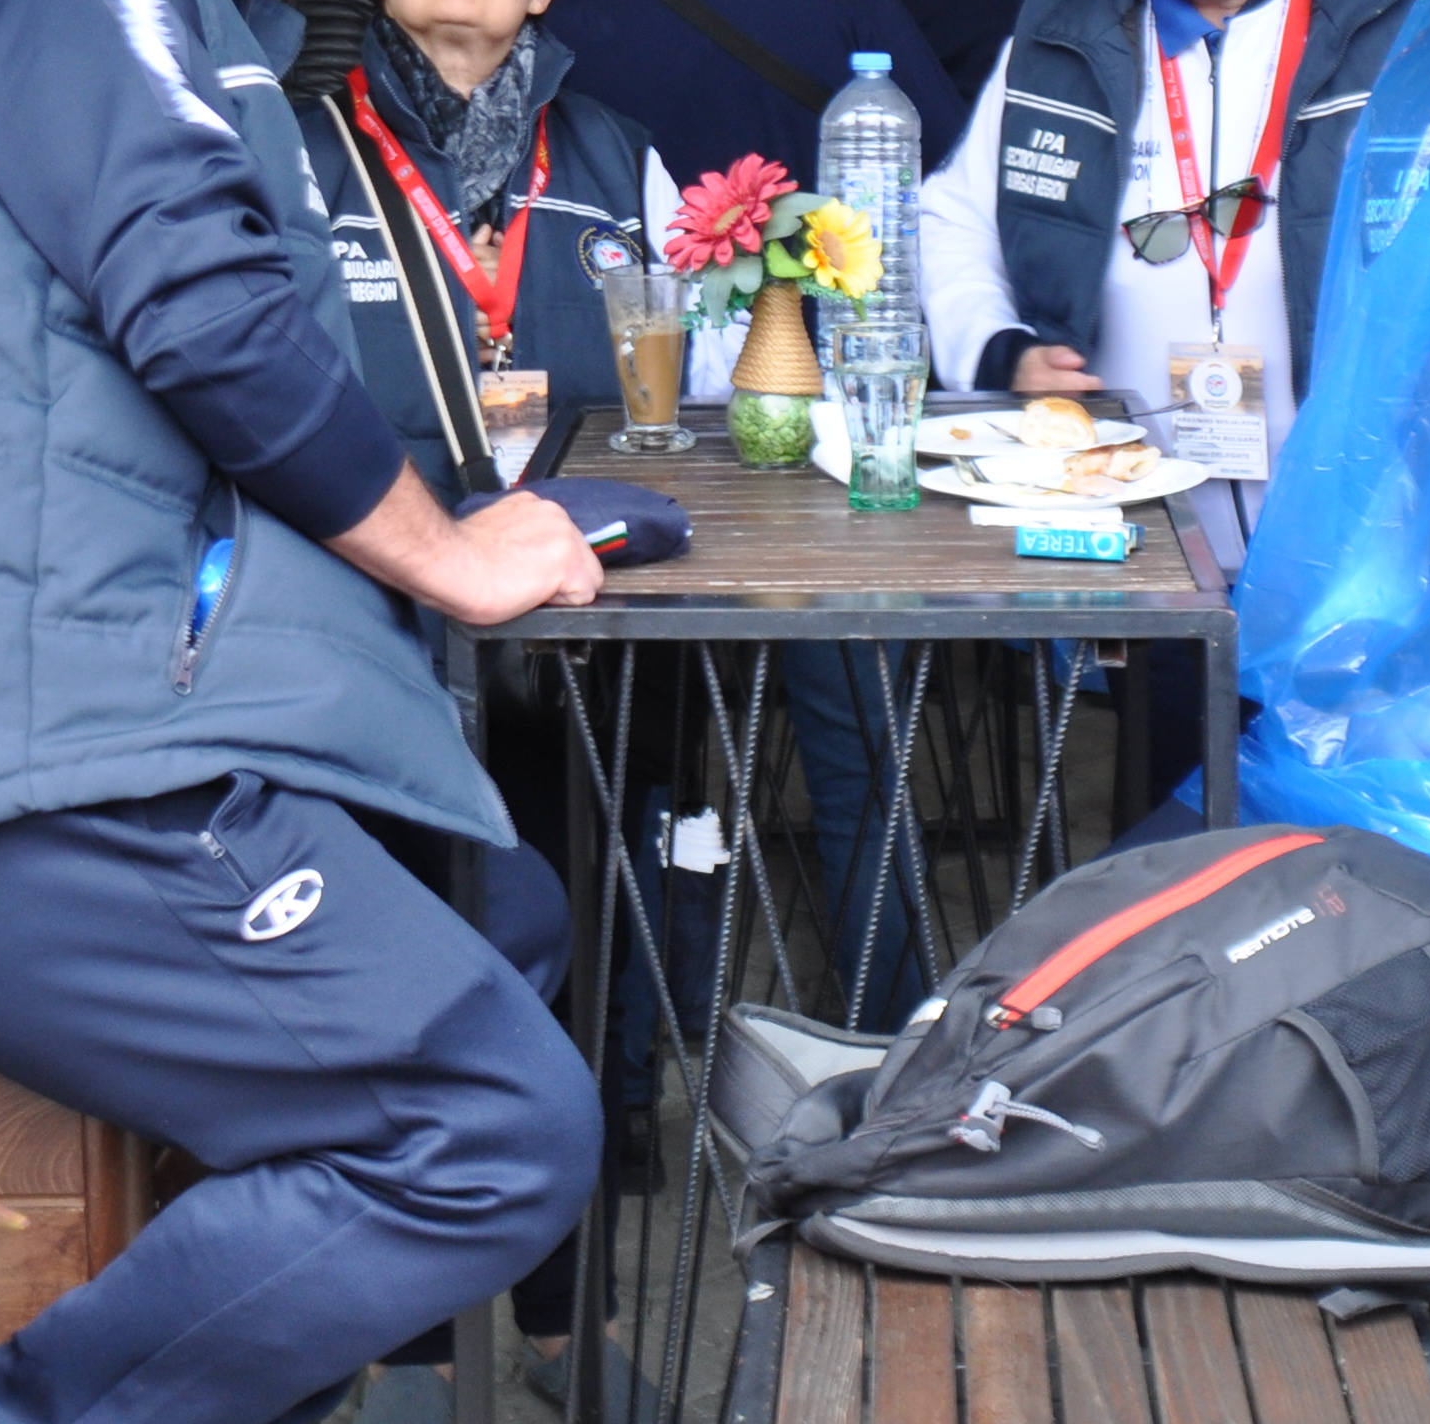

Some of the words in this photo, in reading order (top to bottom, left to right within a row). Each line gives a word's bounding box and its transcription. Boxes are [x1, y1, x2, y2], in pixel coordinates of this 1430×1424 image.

[1030, 128, 1067, 155] IPA
[343, 259, 398, 280] BULGARI
[349, 281, 398, 303] REGION
[1023, 533, 1088, 554] TEREA
